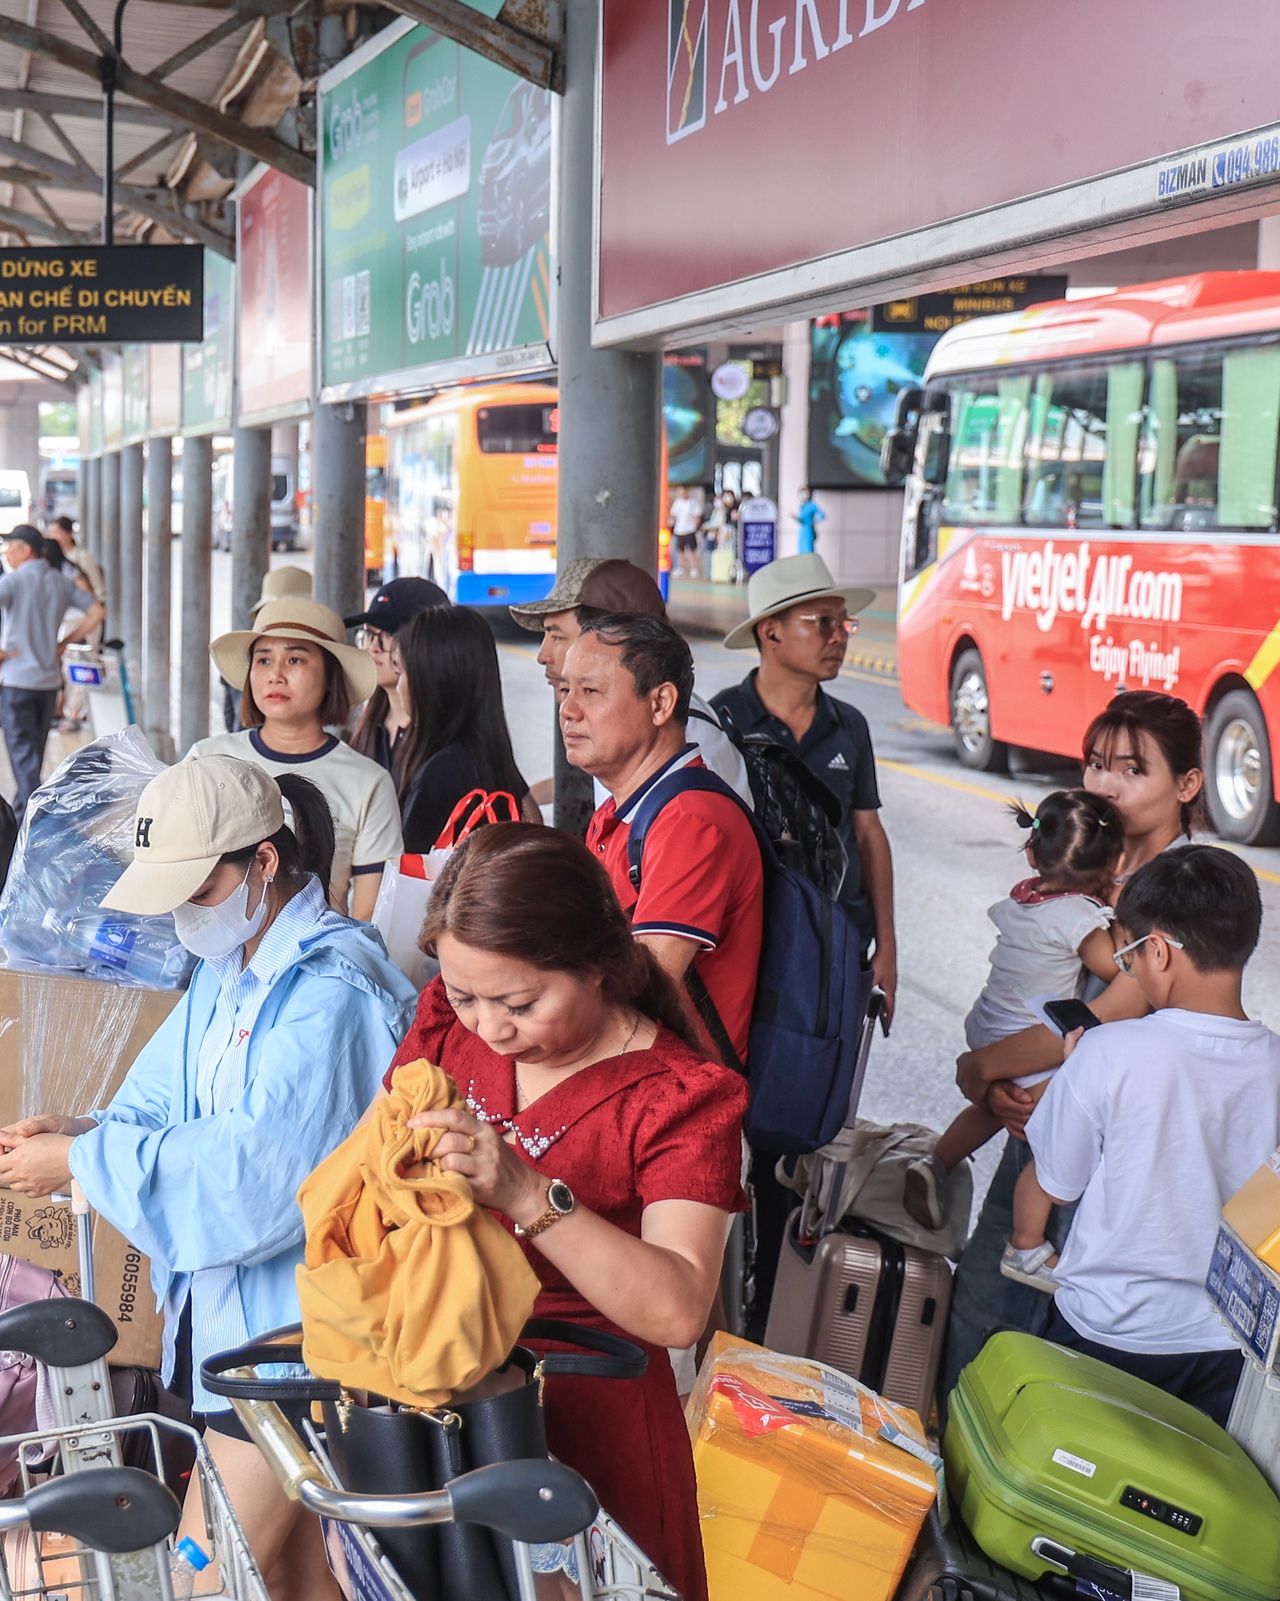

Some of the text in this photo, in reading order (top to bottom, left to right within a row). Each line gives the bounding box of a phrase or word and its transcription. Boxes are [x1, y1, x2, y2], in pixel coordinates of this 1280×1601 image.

[714, 0, 926, 115] AGR
[1158, 158, 1207, 196] BIZMAN
[2, 257, 64, 277] DỪNG
[70, 260, 98, 277] XE
[28, 284, 72, 308] CHẾ
[79, 290, 99, 307] DI
[103, 284, 191, 307] CHUYỂN
[406, 256, 455, 344] Grab
[953, 296, 1015, 312] MINIBUS
[18, 315, 47, 335] for
[53, 316, 107, 334] PRM
[1090, 634, 1180, 691] Enjoy Flying!
[135, 817, 154, 848] H
[6, 1201, 15, 1215] CON
[12, 1223, 20, 1237] MAI
